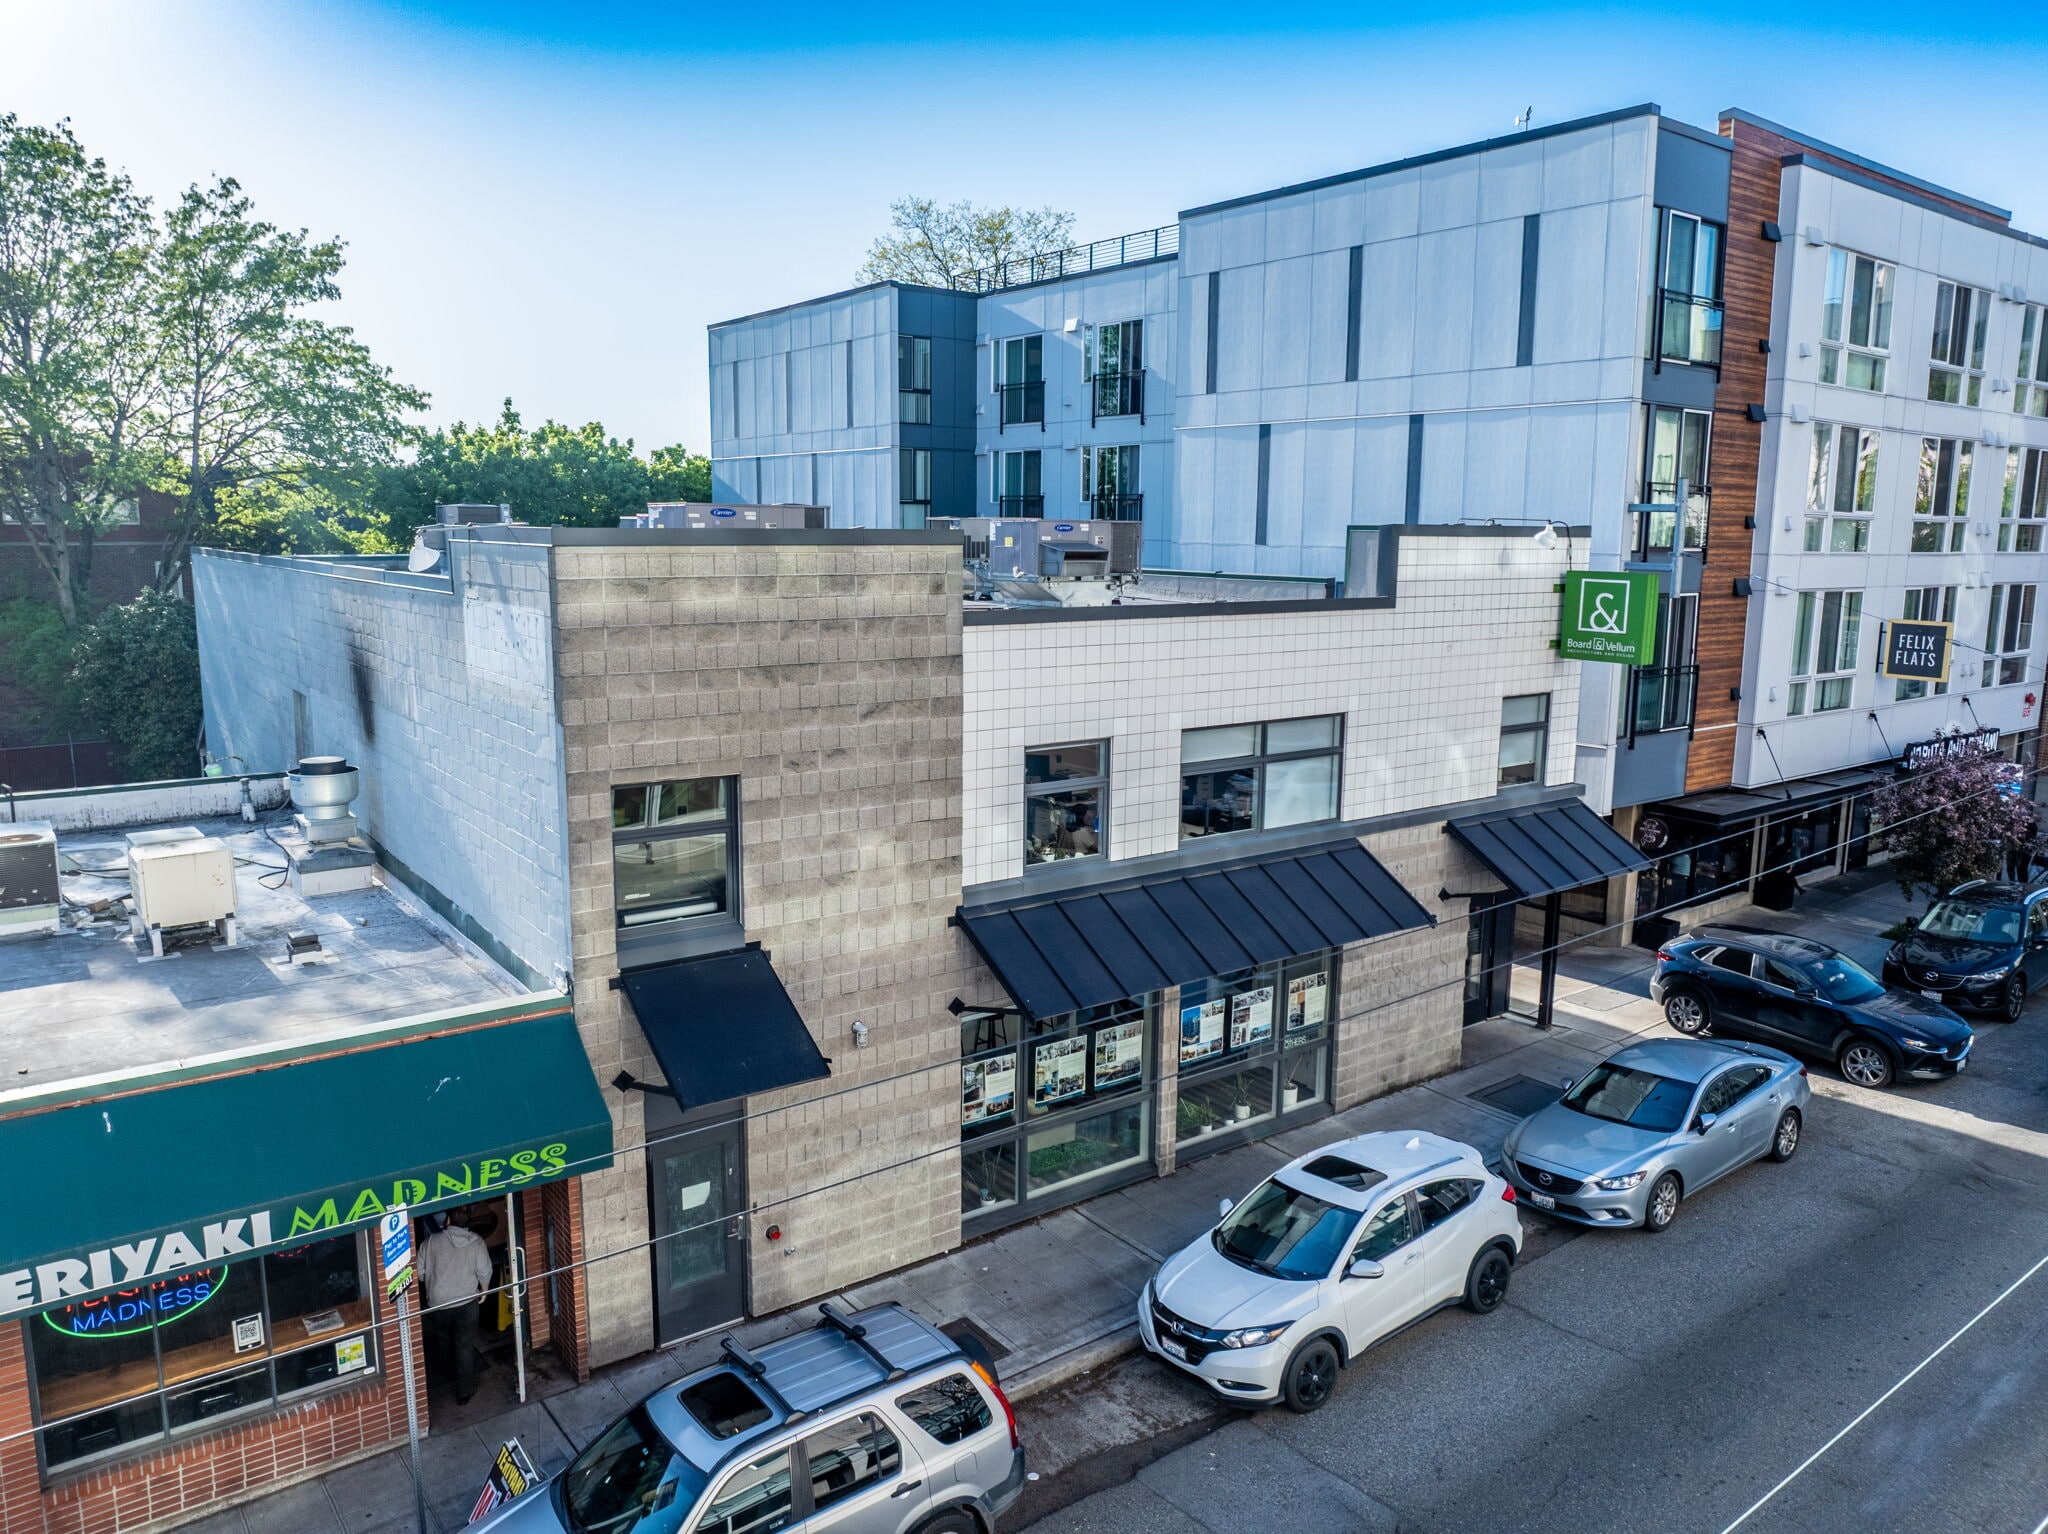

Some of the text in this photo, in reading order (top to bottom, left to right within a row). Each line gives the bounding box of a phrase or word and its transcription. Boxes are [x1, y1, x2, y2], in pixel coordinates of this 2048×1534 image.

[1589, 592, 1621, 632] &
[1567, 638, 1592, 649] Board
[1606, 641, 1635, 653] Vellum
[1895, 650, 1936, 667] FLATS
[1898, 633, 1935, 650] FELIX
[280, 1143, 568, 1245] MADNESS
[73, 1283, 210, 1333] MADNESS
[497, 1445, 526, 1497] TERIYAKI
